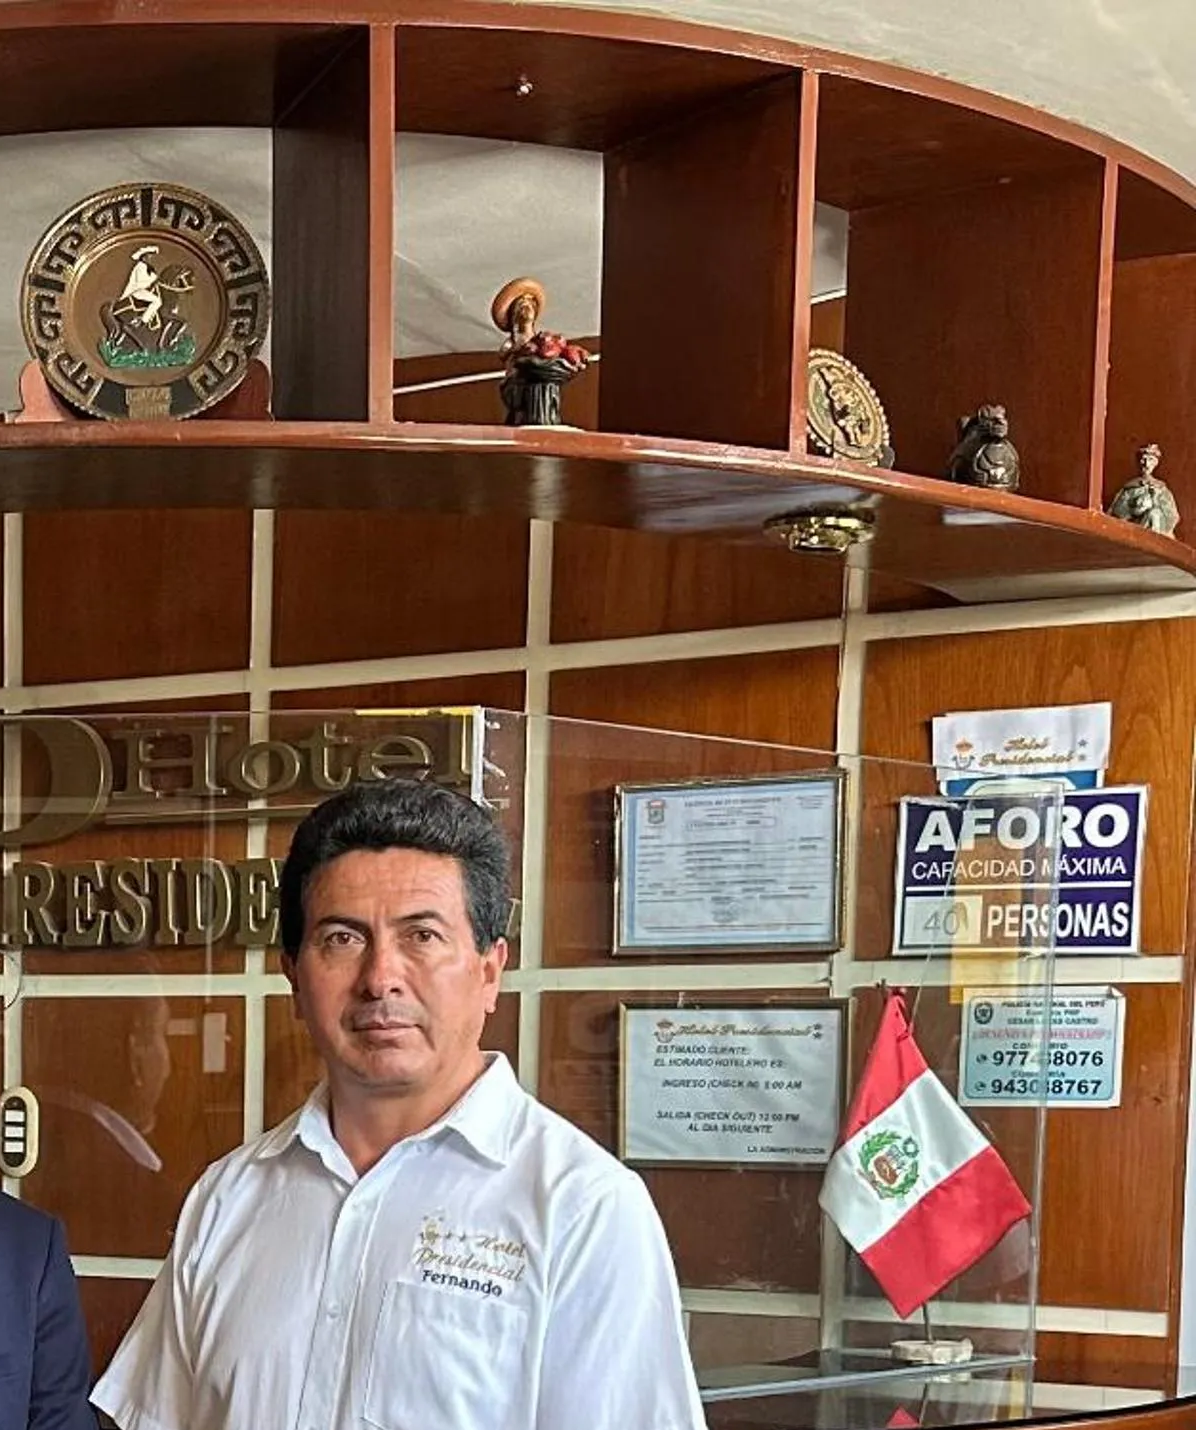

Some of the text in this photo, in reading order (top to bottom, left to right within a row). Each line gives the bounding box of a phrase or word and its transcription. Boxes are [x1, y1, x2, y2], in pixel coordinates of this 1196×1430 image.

[112, 716, 480, 798] Hotel
[915, 803, 1130, 852] AFORO
[912, 858, 1035, 880] CAPACIDAD
[987, 902, 1130, 938] PERSONAS
[654, 1058, 666, 1067] EL
[412, 1247, 526, 1282] Presidencial
[421, 1269, 503, 1298] Fernando
